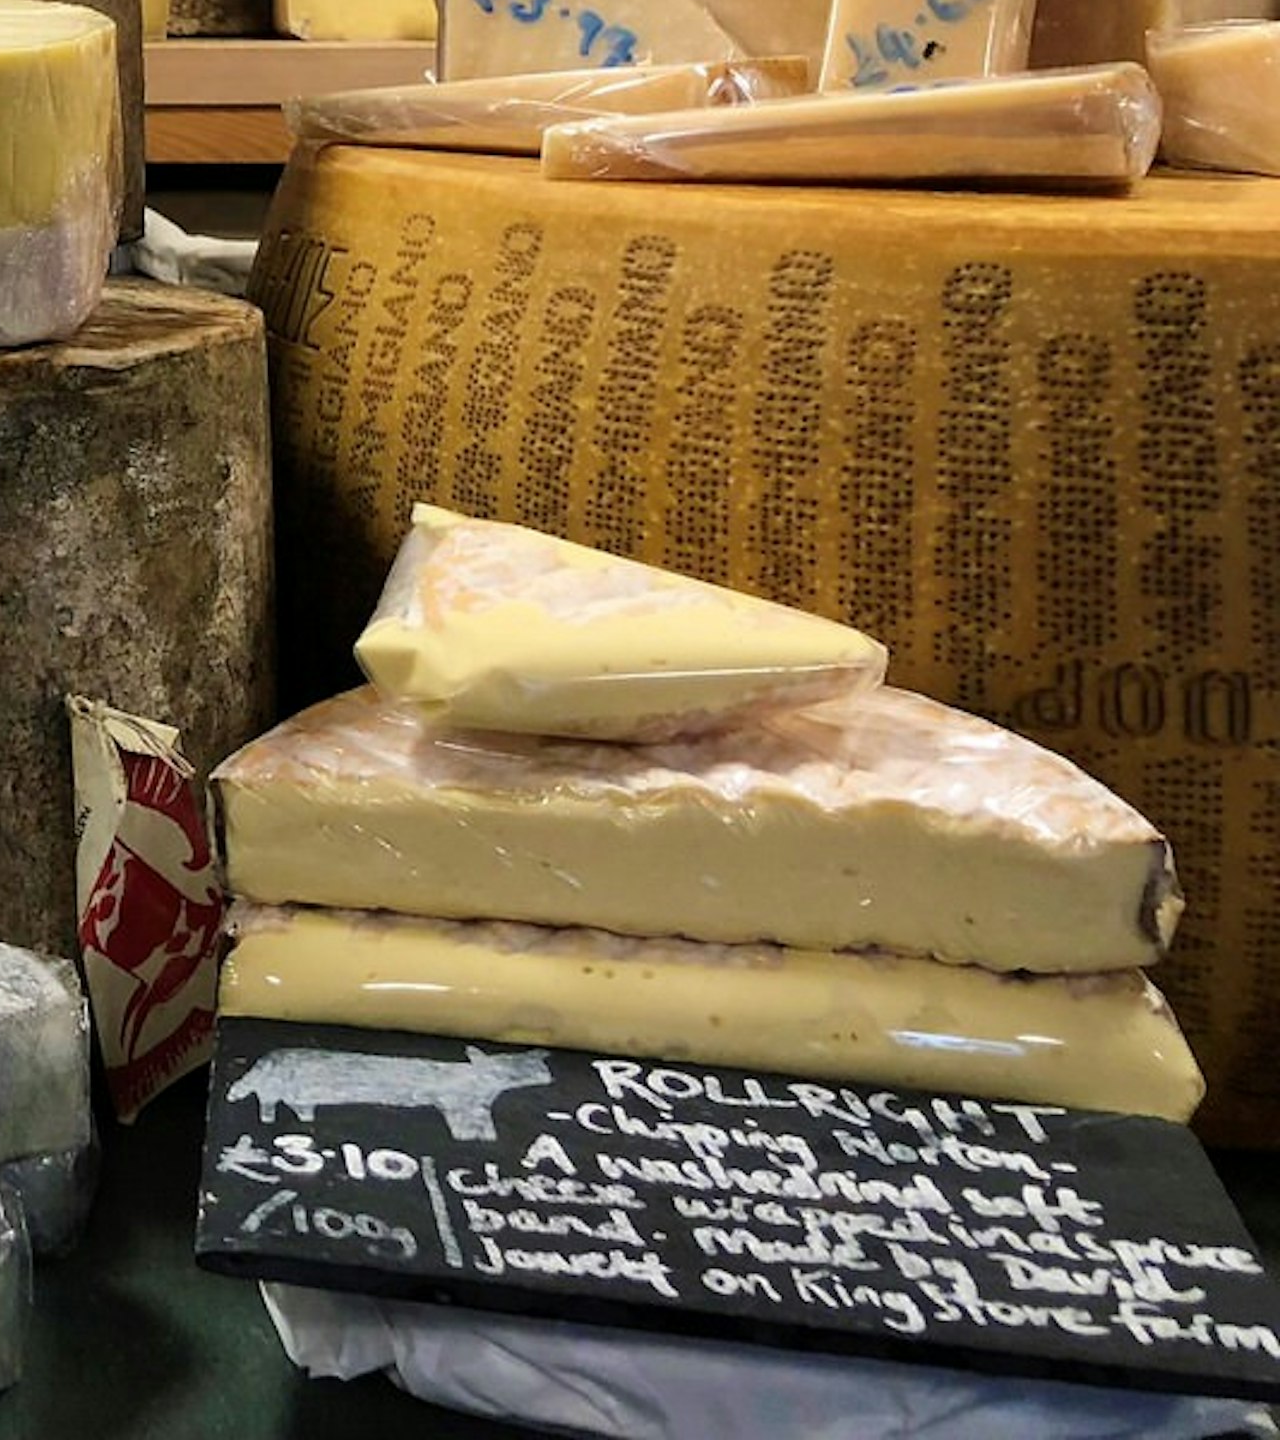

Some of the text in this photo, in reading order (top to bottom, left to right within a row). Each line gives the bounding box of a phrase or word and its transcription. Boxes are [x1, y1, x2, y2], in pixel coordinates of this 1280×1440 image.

[591, 1059, 1067, 1143] ROLLRIGHT
[217, 1134, 419, 1184] £3.10
[521, 1133, 577, 1176] A
[701, 1267, 783, 1302] on
[790, 1267, 927, 1334] King
